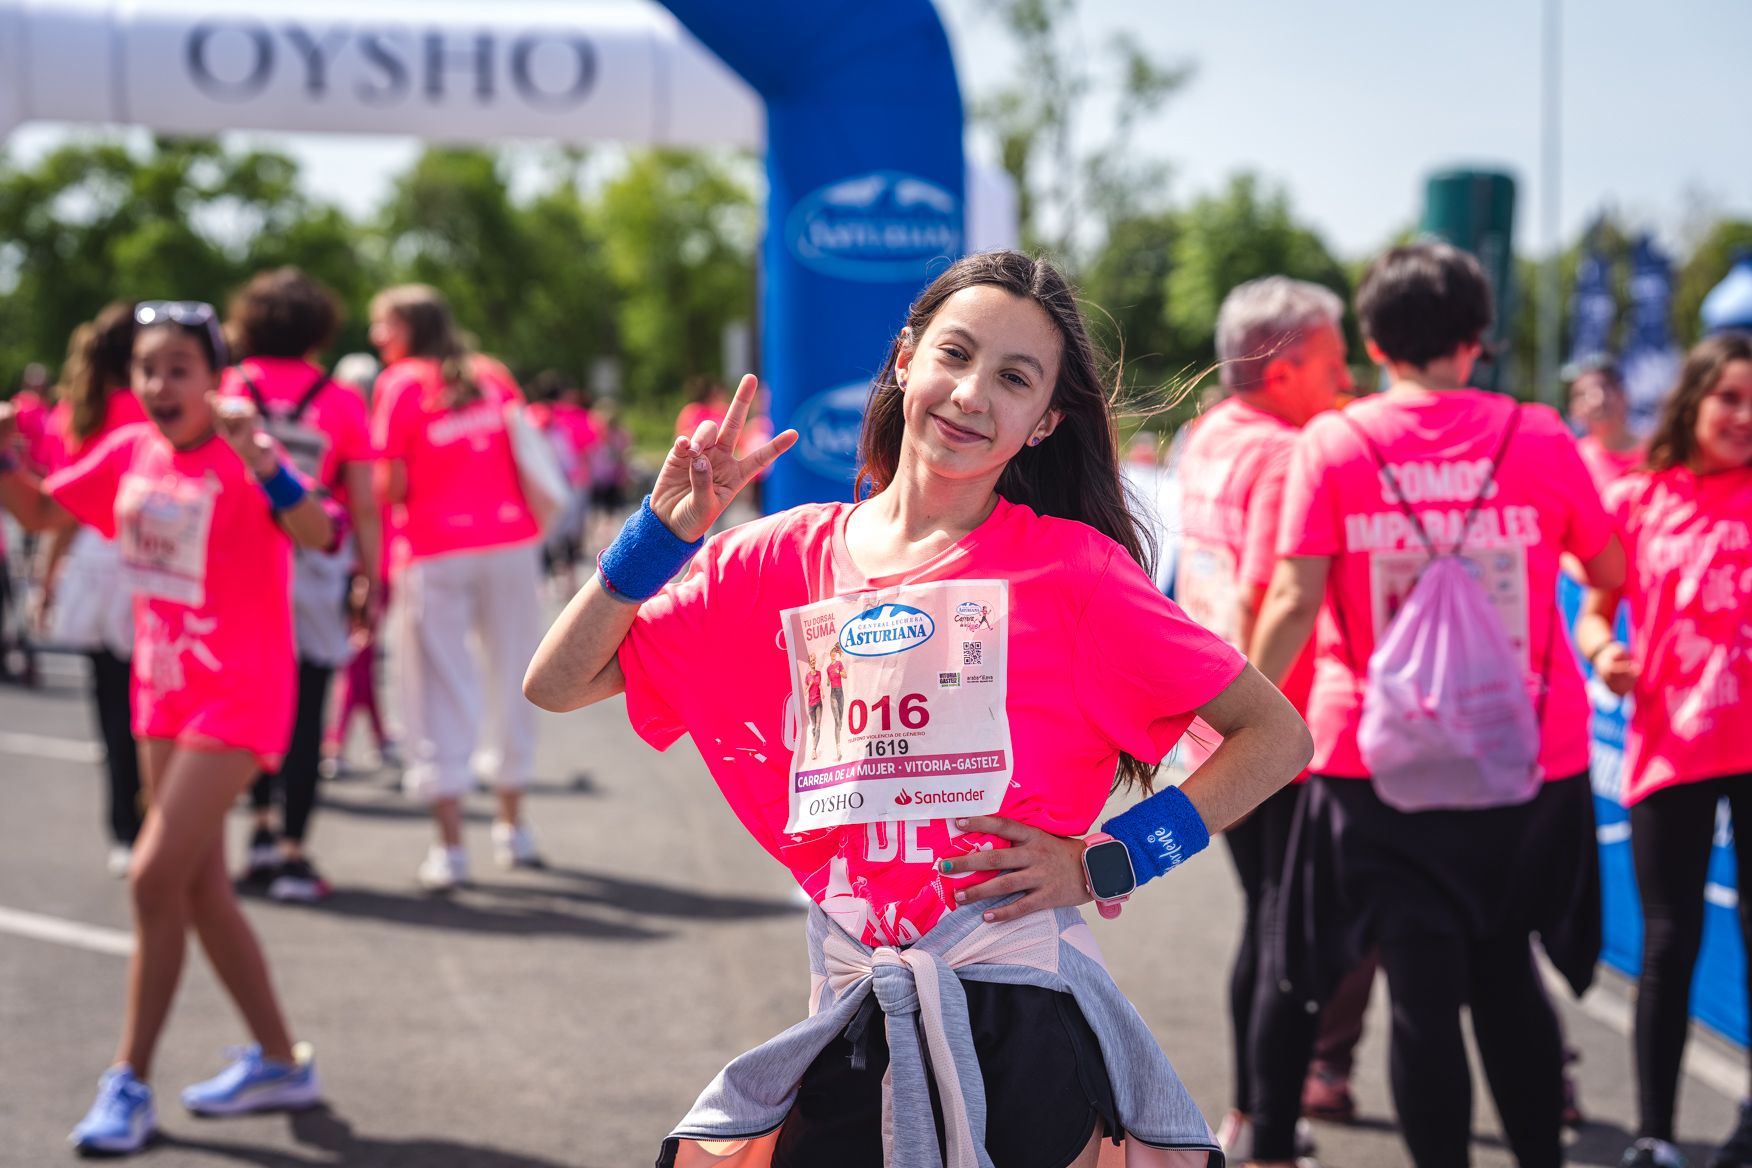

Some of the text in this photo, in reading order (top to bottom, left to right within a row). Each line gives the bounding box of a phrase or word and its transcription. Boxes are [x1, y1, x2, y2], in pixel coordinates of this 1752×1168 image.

[183, 17, 600, 113] OYSHO
[1378, 458, 1498, 505] SOMOS
[1345, 506, 1541, 553] IMPARABLES
[804, 613, 835, 628] TU DORSAL
[806, 621, 836, 641] SUMA
[858, 617, 923, 630] CENTRAL LECHERA
[845, 624, 927, 648] ASTURIANA
[848, 692, 930, 735] 016
[865, 739, 909, 757] 1619
[797, 755, 1000, 788] CARRERA DE LA MUJER VITORIA-GASTEIZ
[809, 788, 985, 816] OYSHO Santander
